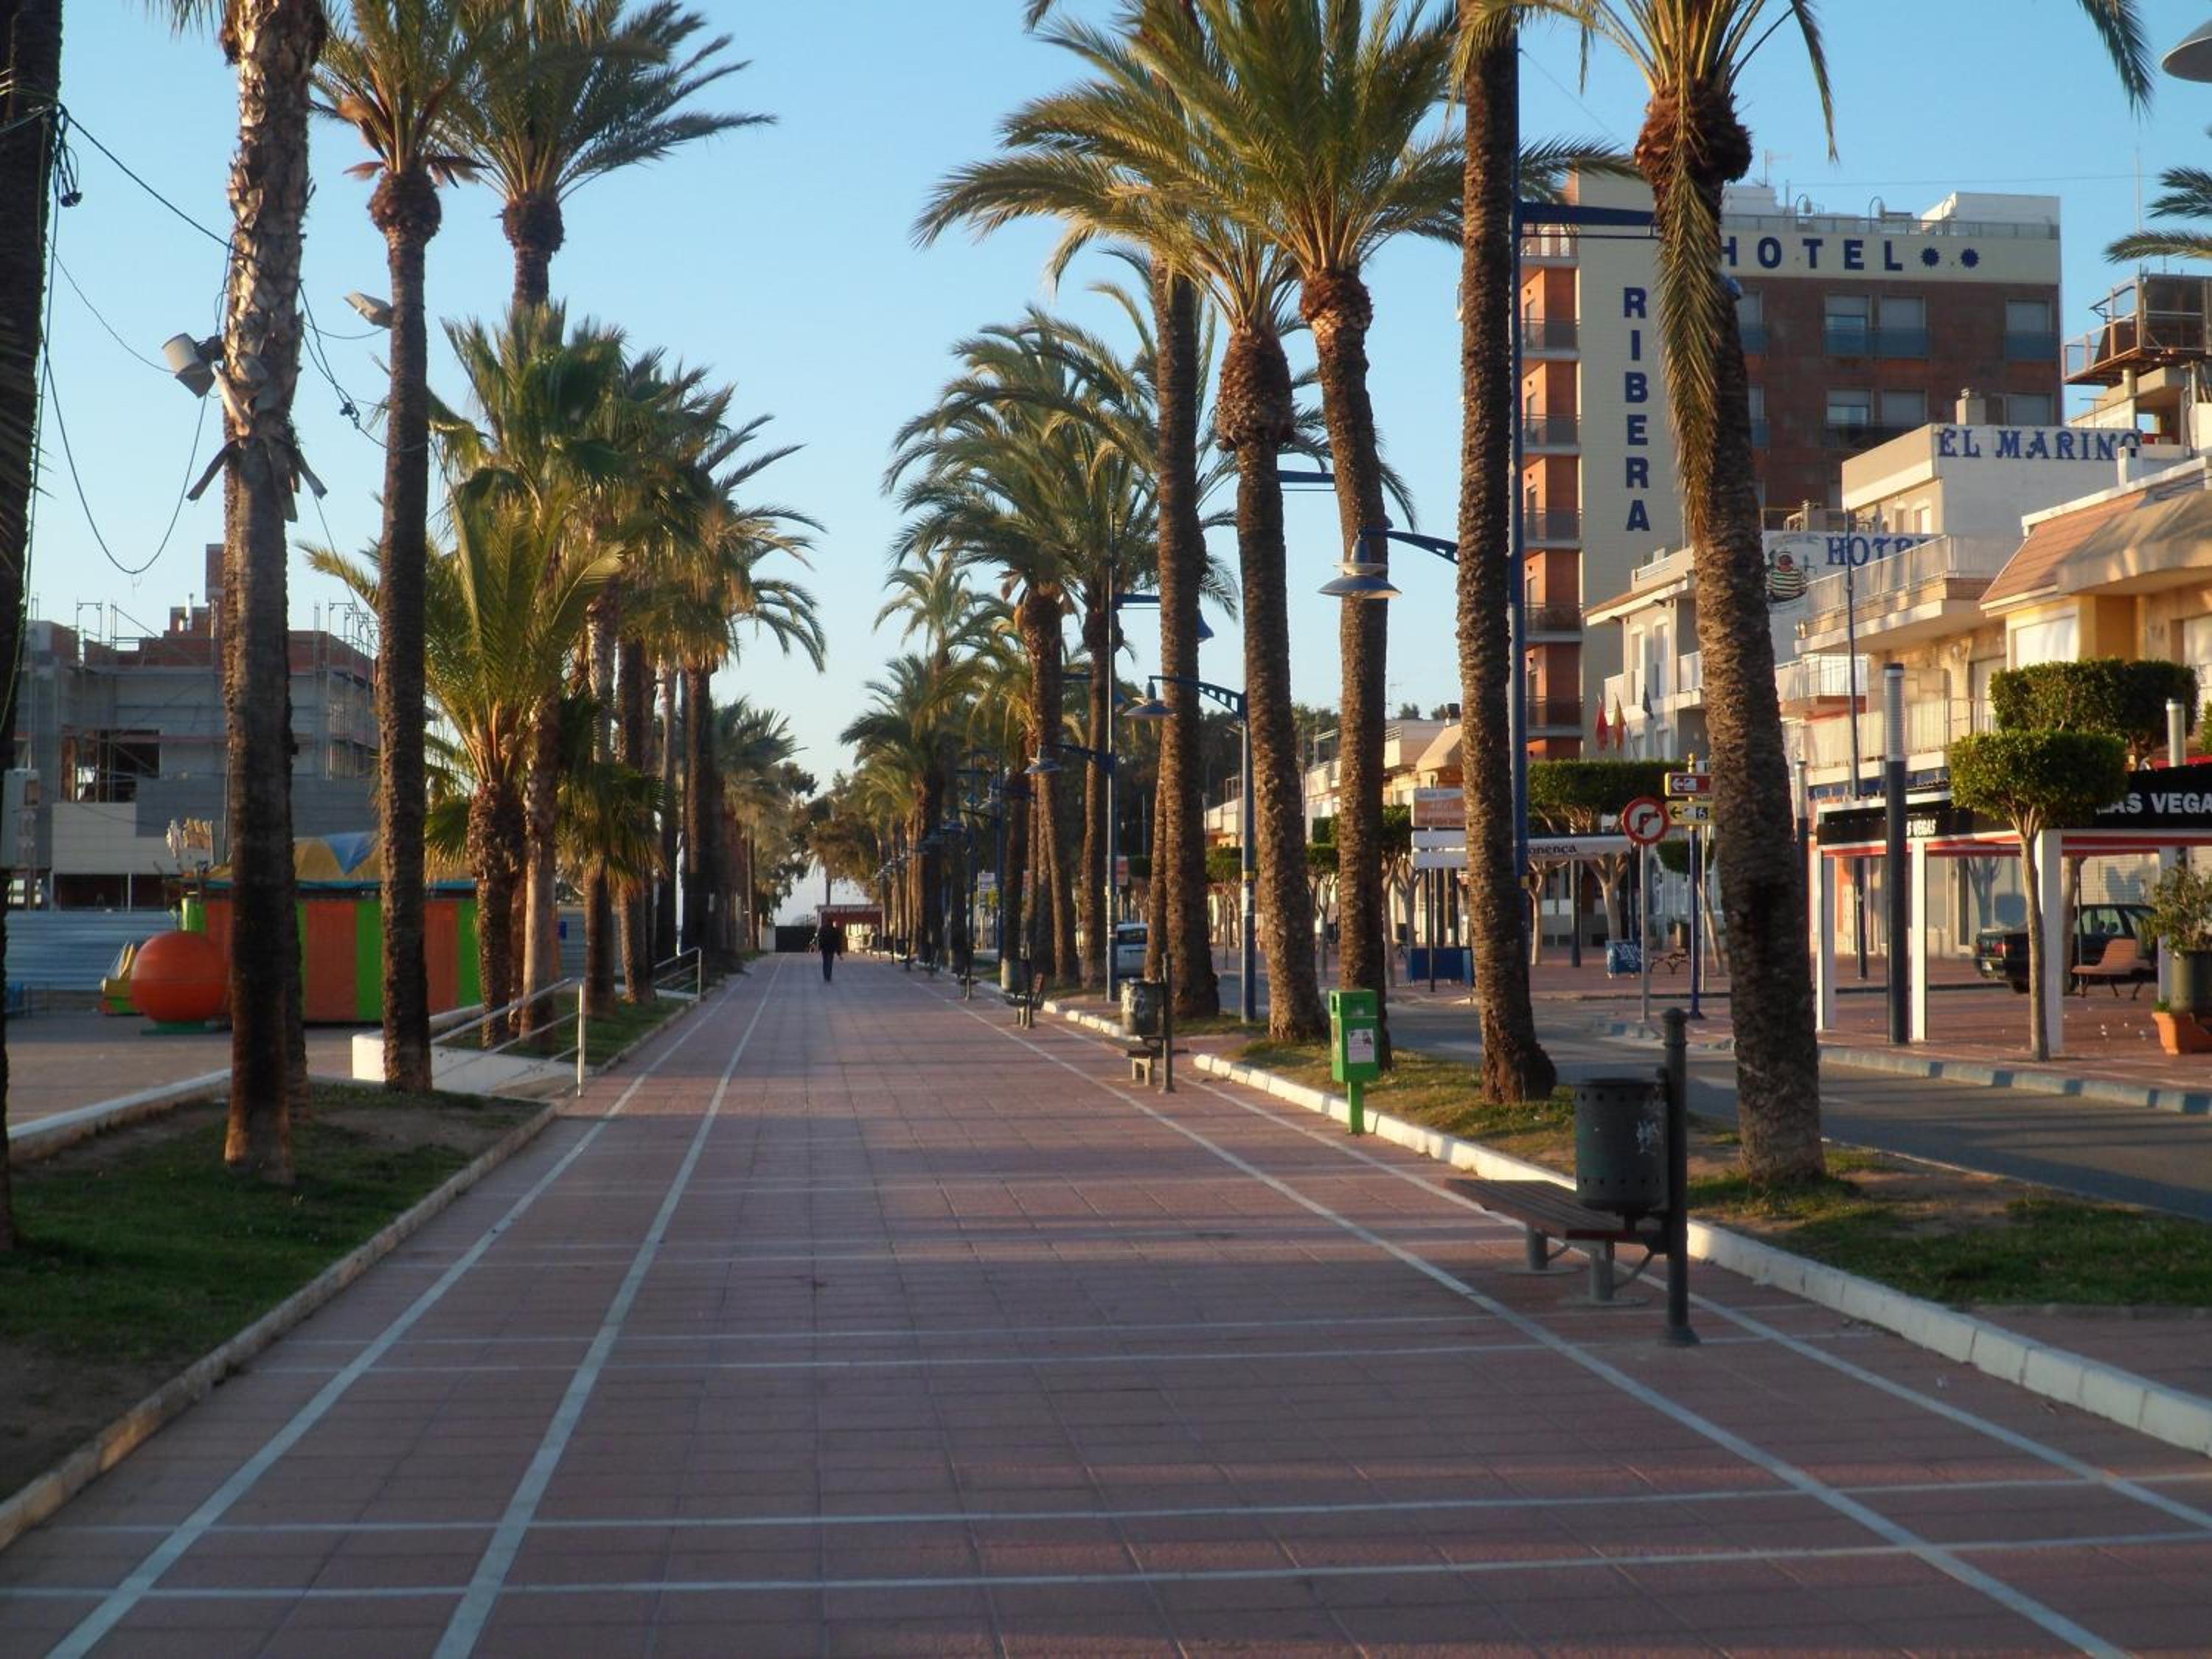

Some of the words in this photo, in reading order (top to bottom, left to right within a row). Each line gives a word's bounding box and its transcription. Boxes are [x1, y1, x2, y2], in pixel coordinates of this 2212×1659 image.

[1722, 236, 1904, 272] HOTEL
[1624, 286, 1651, 532] RIBERA
[1937, 427, 1982, 458] EL
[1913, 818, 1936, 836] VEGAS
